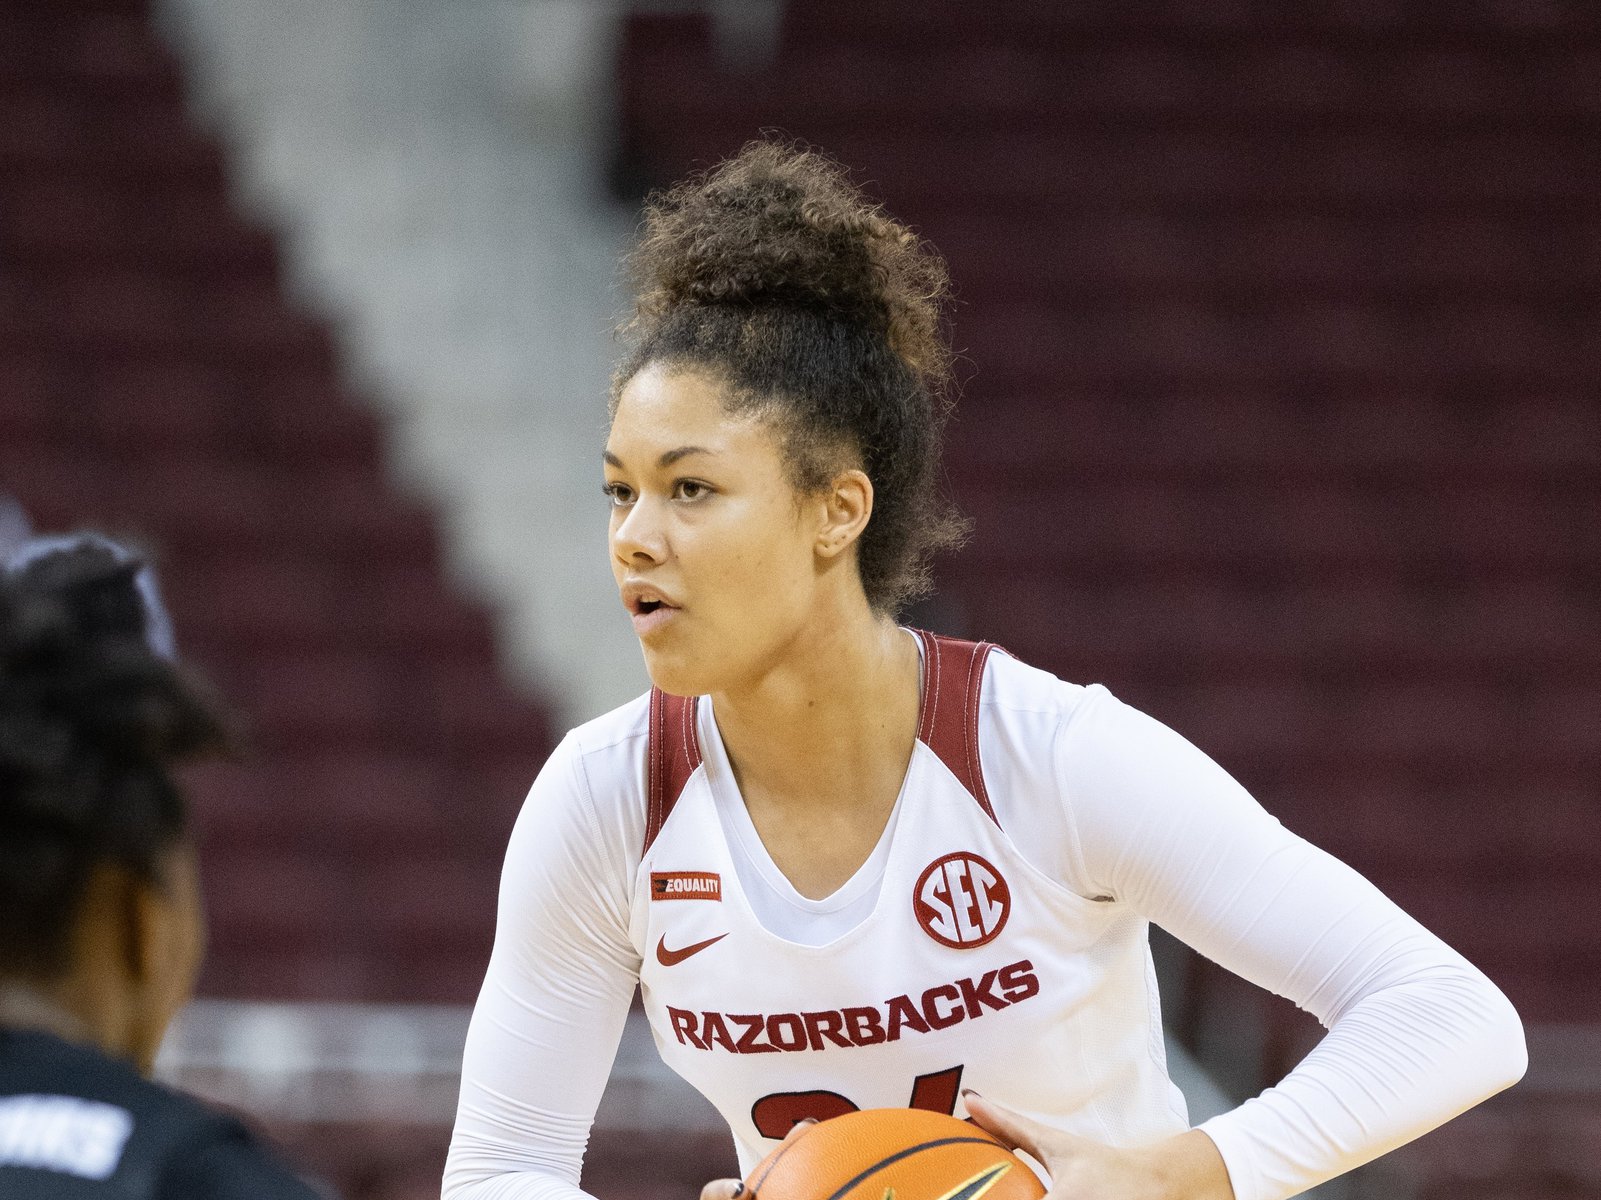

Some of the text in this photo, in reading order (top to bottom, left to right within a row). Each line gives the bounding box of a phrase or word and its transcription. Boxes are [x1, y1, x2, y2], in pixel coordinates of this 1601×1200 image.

[665, 877, 719, 893] EQUALITY
[919, 857, 1004, 944] SEC
[666, 959, 1040, 1054] RAZORBACKS
